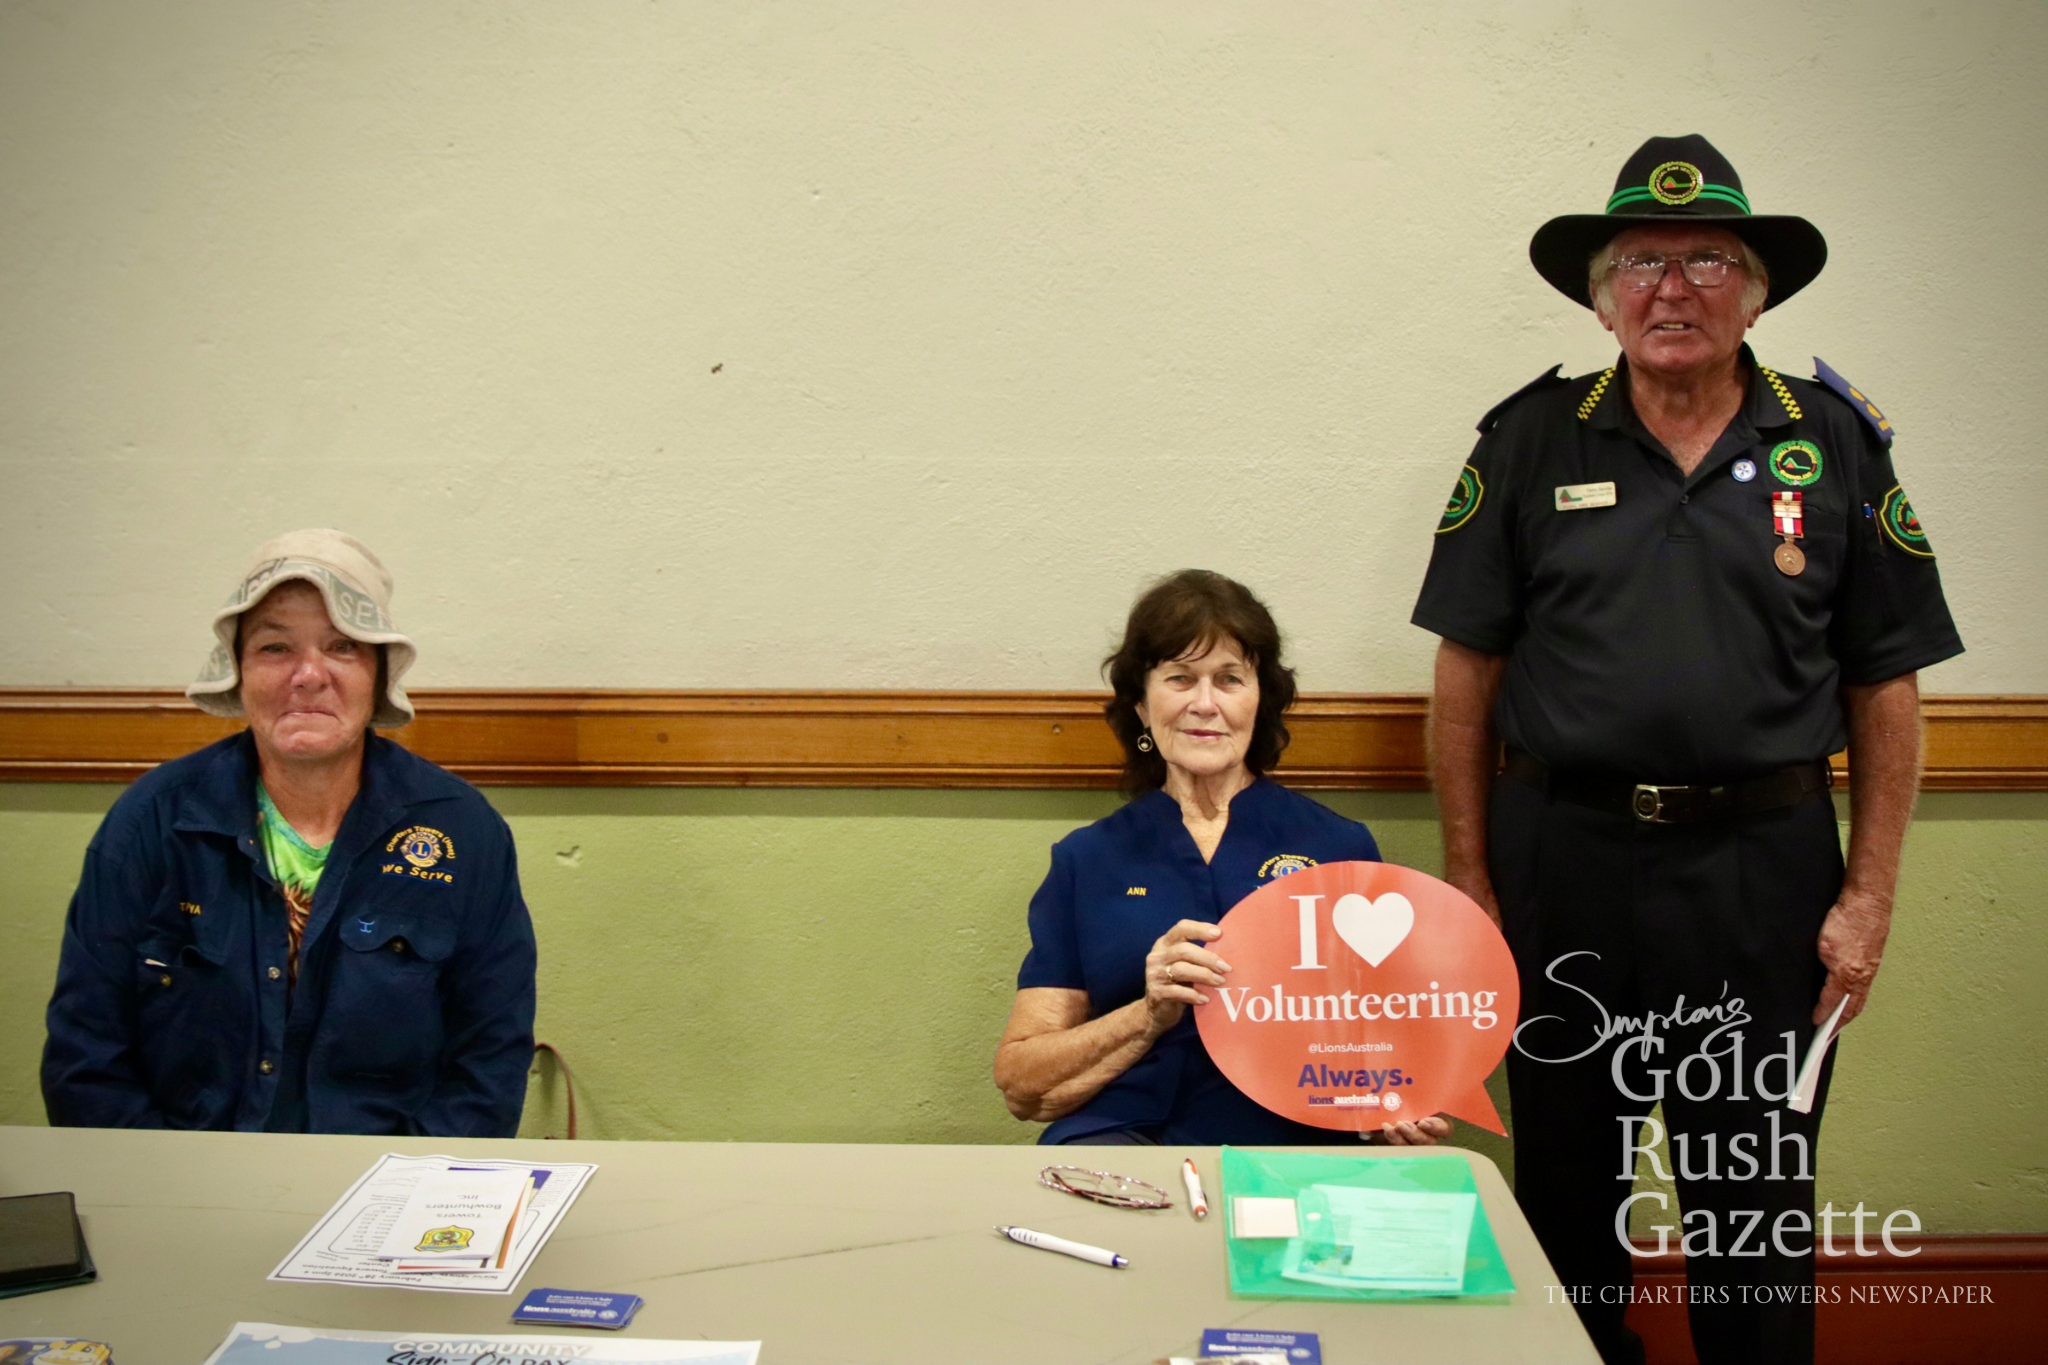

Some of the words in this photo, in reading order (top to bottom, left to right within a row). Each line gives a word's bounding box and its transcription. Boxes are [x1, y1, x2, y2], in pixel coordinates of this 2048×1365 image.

[386, 828, 413, 852] Charters
[413, 825, 444, 838] Towers
[382, 864, 403, 873] We
[409, 866, 453, 883] Serve
[1126, 886, 1147, 896] ANN
[1288, 894, 1328, 970] I
[1215, 981, 1498, 1030] Volunteering
[1308, 1042, 1394, 1053] @LionsAustralia
[1297, 1063, 1414, 1093] Always.
[379, 1274, 422, 1282] February
[393, 1341, 590, 1356] COMMUNITY
